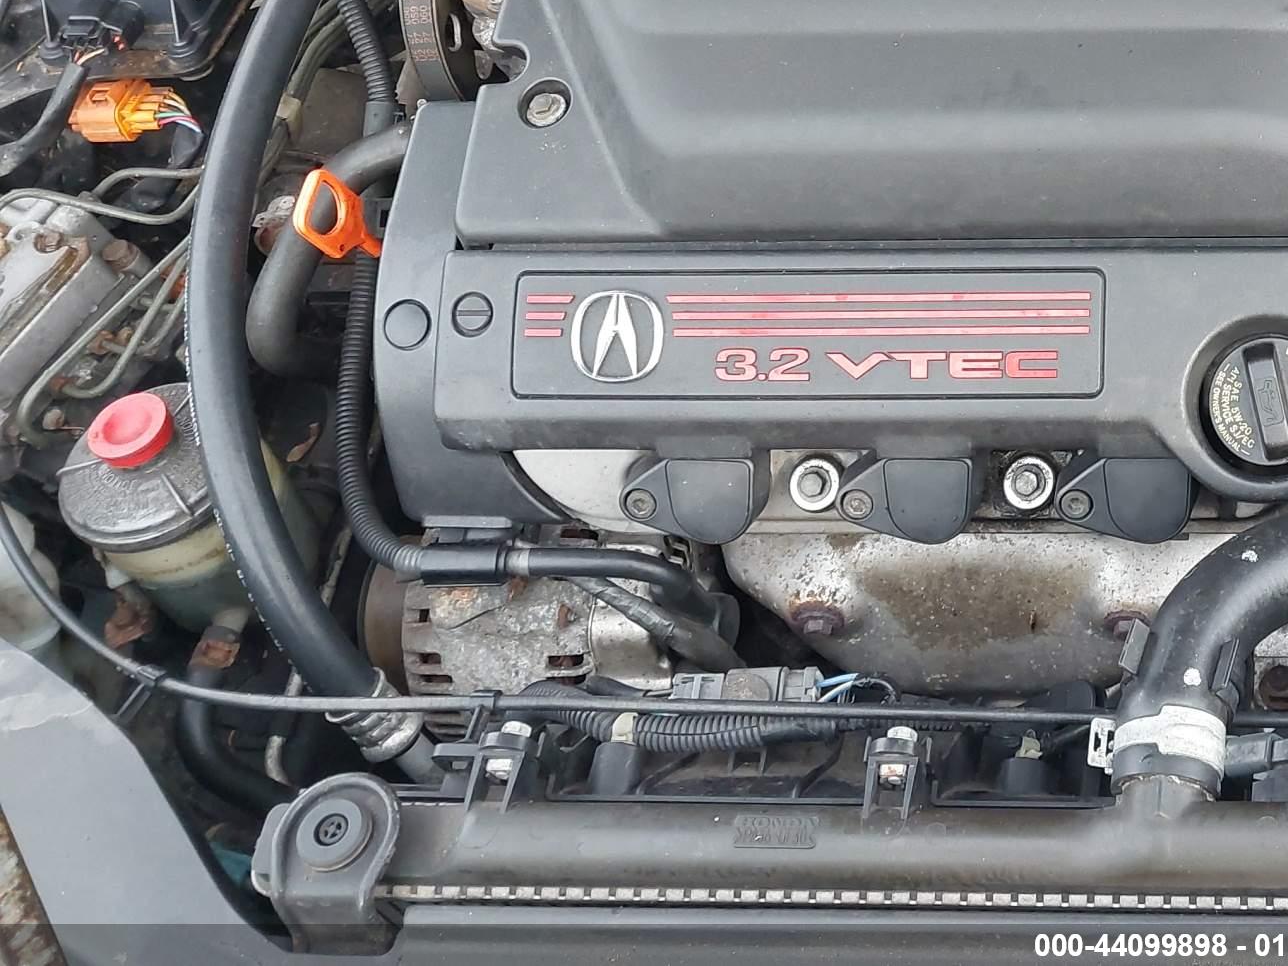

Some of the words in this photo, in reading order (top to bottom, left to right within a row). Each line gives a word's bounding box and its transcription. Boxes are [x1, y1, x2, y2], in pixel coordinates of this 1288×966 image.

[714, 347, 810, 382] 3.2
[825, 350, 1059, 380] VTEC
[1218, 383, 1233, 425] SERVICE
[1230, 381, 1243, 402] SAE
[1217, 423, 1241, 452] MANUAL
